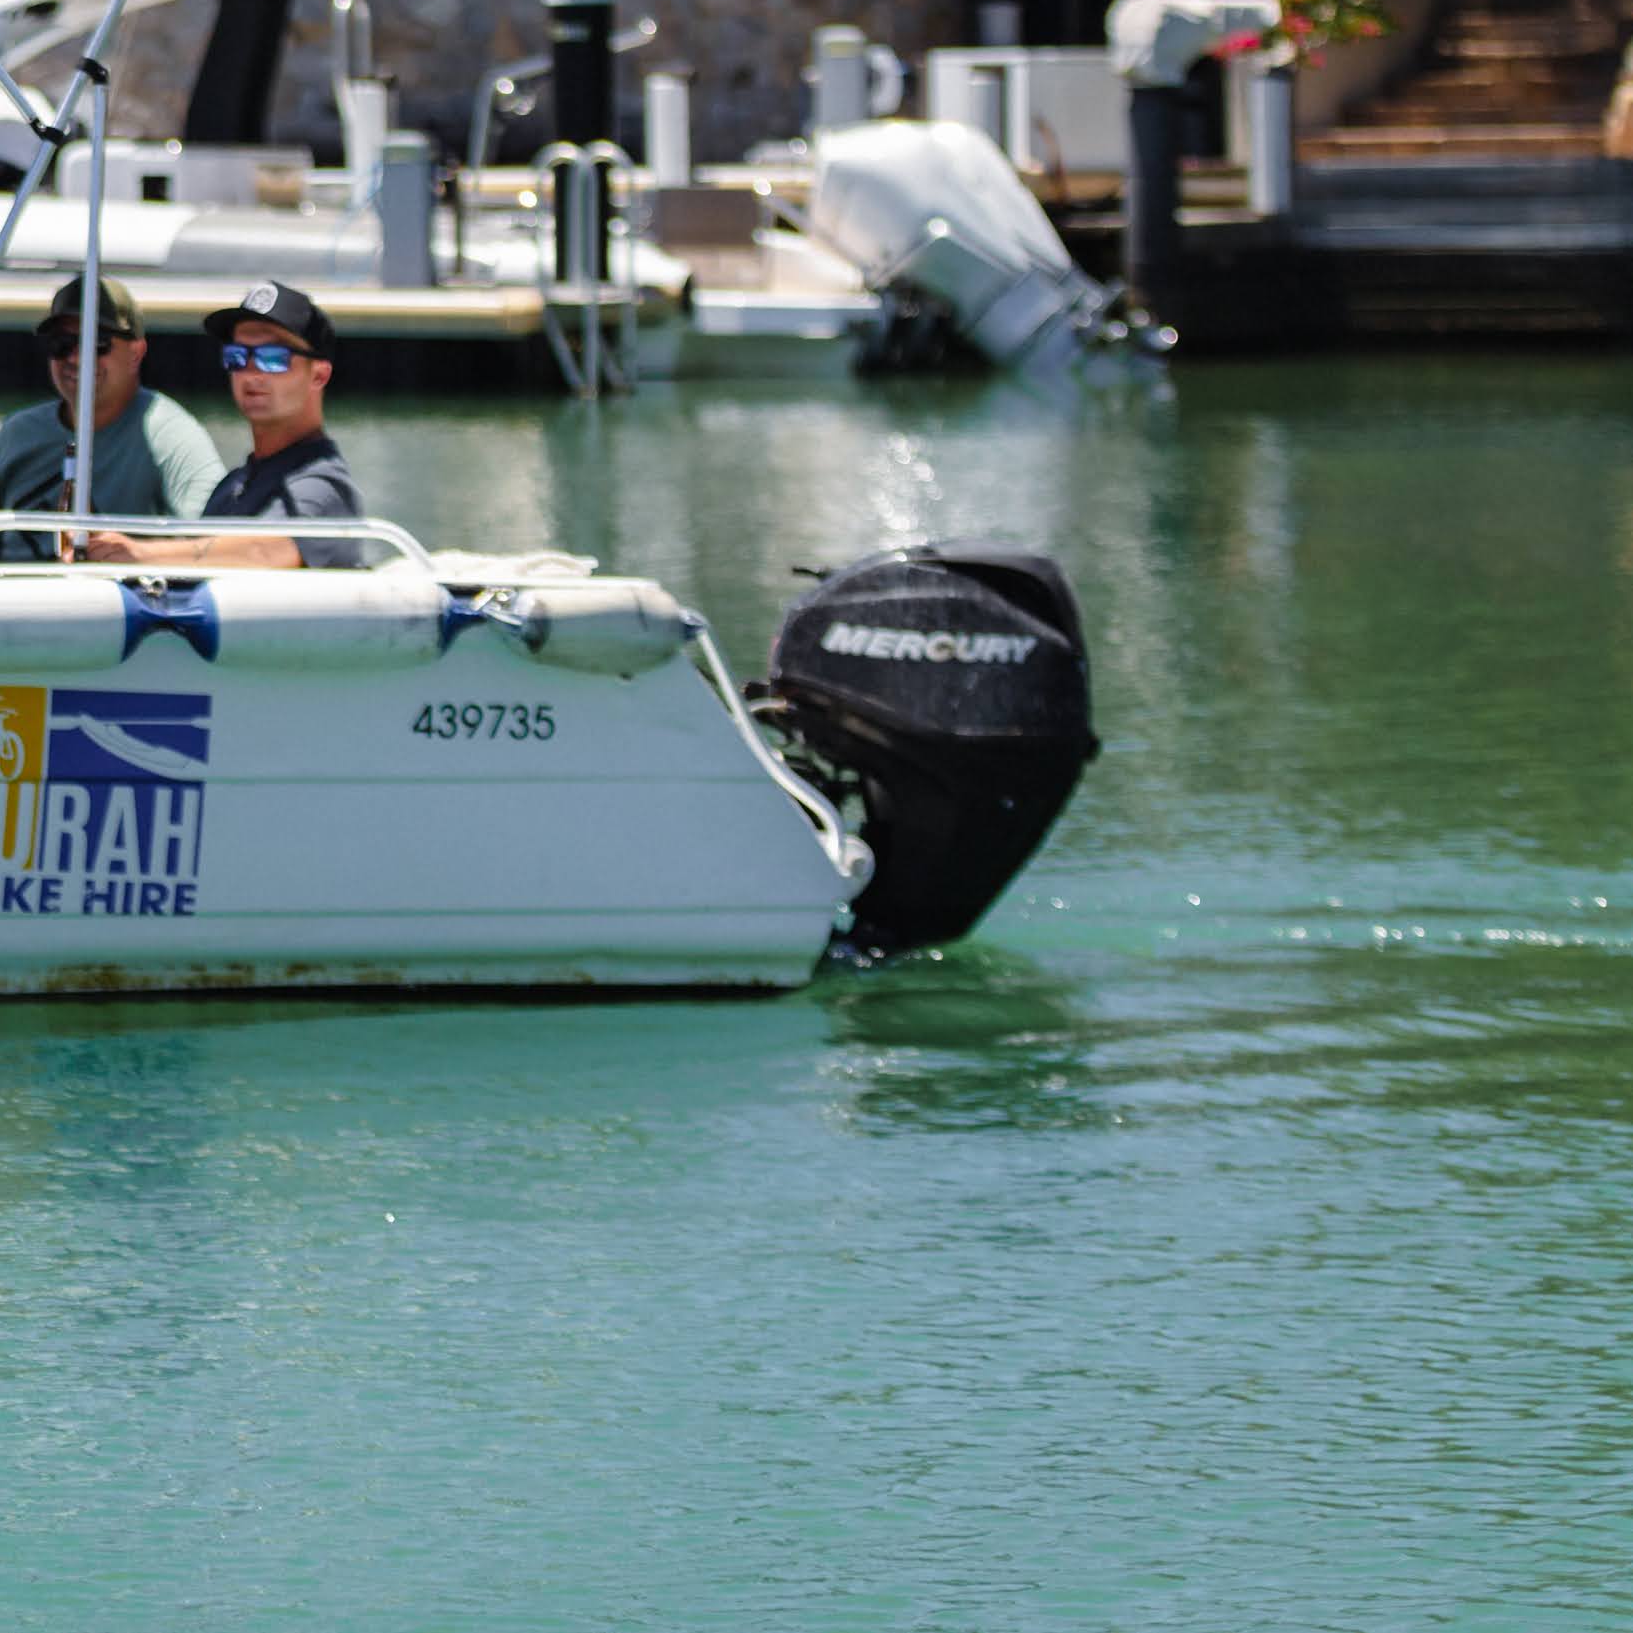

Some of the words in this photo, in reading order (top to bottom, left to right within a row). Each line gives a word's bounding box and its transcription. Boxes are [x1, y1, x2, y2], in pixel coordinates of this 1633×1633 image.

[821, 622, 1038, 665] MERCURY
[412, 703, 556, 741] 439735
[83, 880, 199, 916] HIRE
